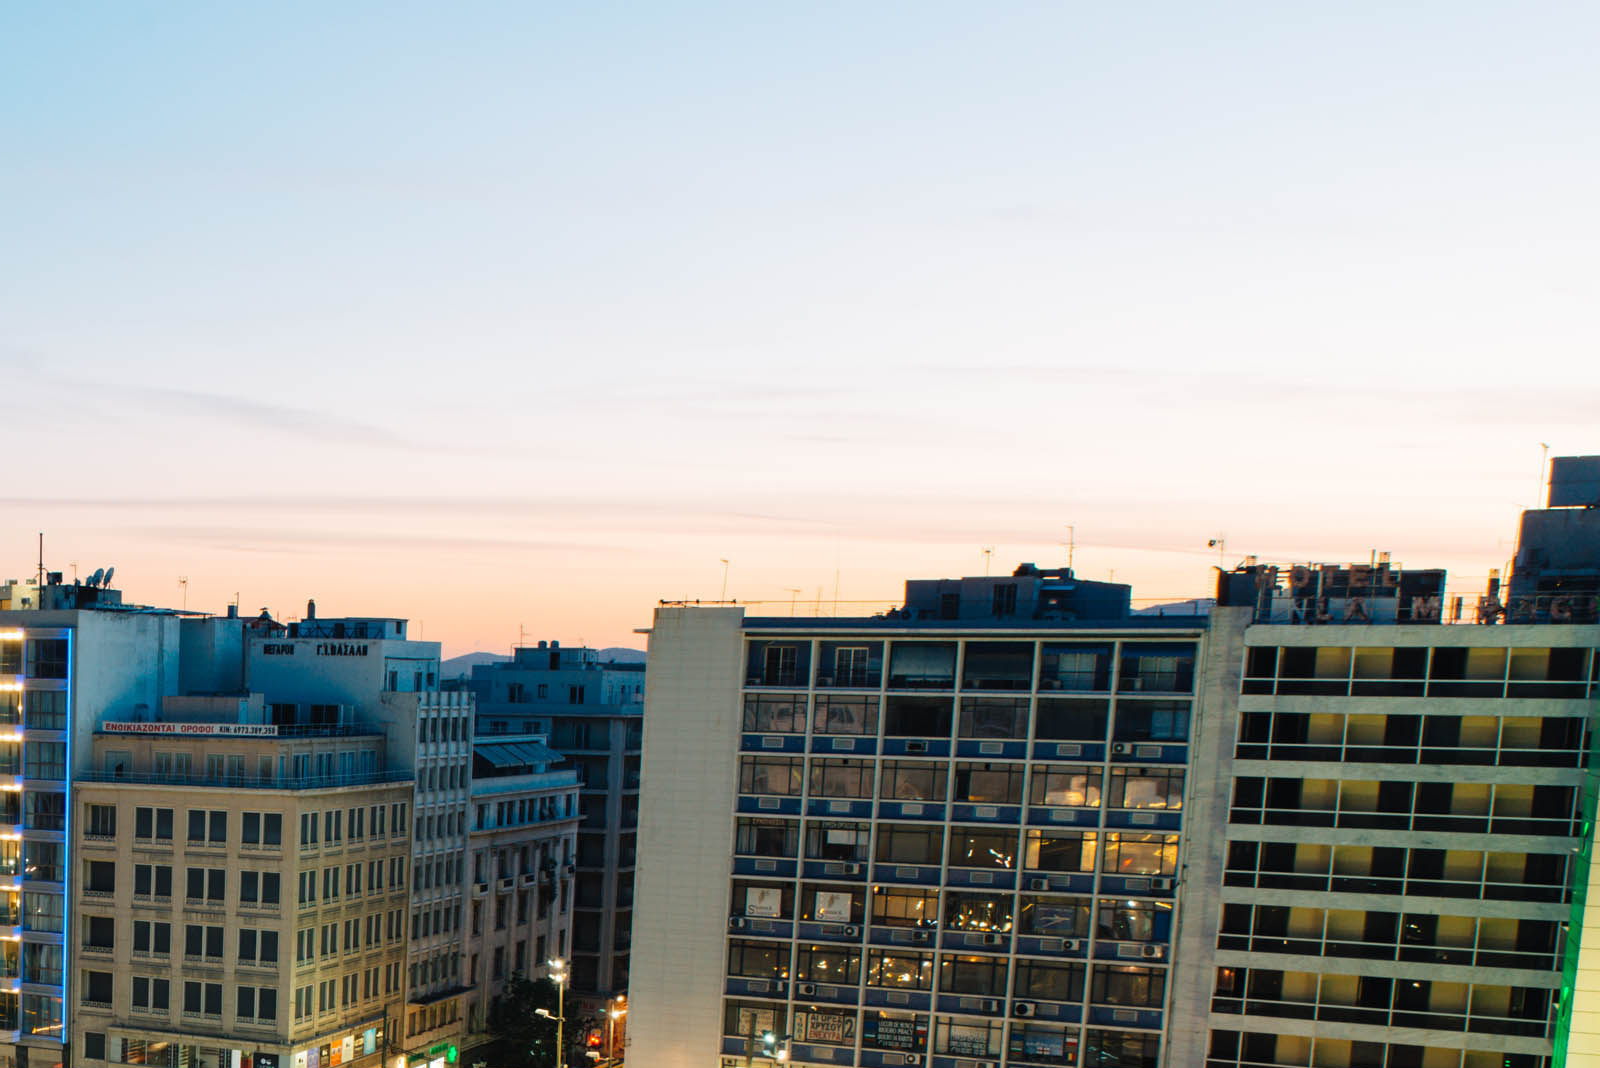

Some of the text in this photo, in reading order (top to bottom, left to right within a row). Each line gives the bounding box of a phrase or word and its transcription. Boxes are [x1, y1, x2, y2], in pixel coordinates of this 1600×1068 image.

[1256, 563, 1400, 588] HOTEL
[105, 722, 215, 734] ΕΝΟΙΚΙΑΖΟΝΤΑΙ ΟΡΟΦΟΙ
[810, 1022, 842, 1032] ΧΡΥΣΟΥ
[845, 1019, 854, 1038] 2
